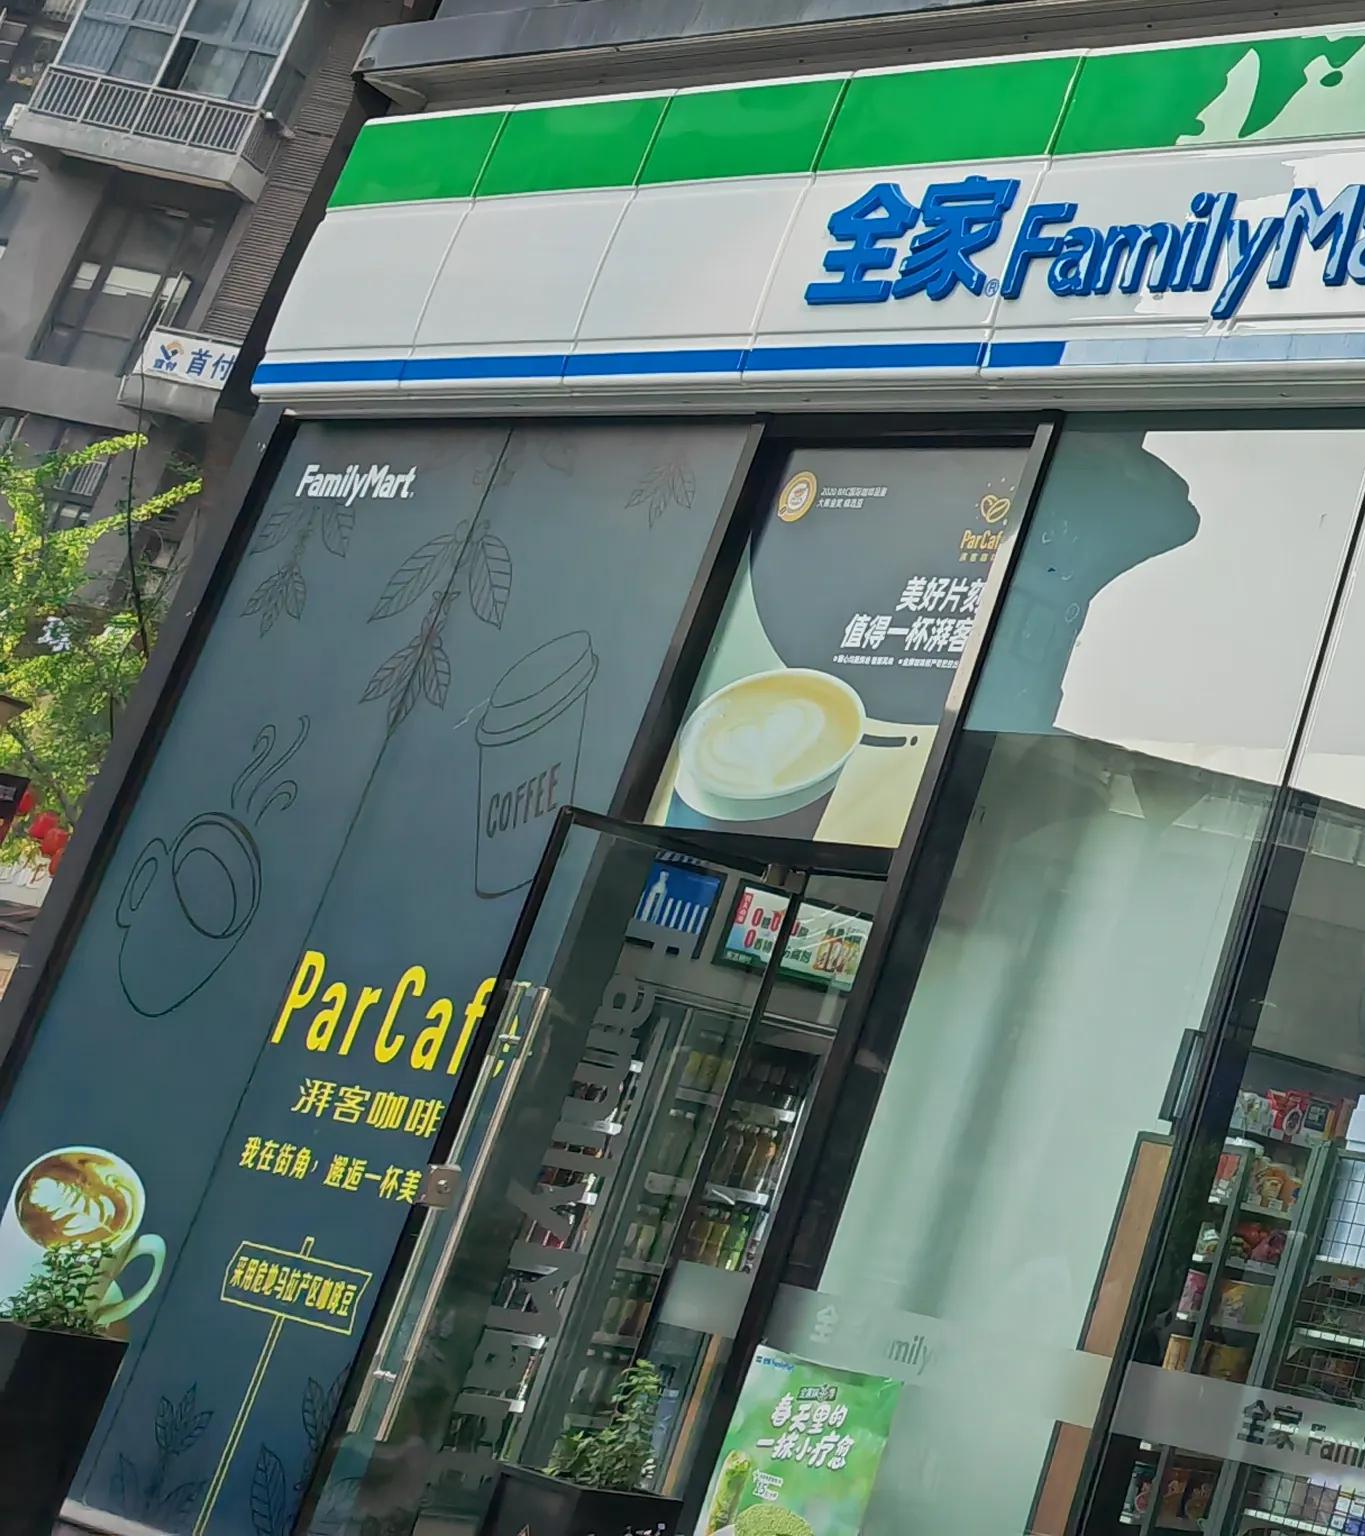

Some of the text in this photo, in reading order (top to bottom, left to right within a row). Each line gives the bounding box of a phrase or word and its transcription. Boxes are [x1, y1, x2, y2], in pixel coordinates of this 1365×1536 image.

[805, 175, 1020, 305] 全家
[295, 464, 415, 507] FamilyMart
[959, 530, 1003, 550] ParCaf
[486, 762, 561, 839] COFFEE
[290, 1077, 442, 1140] 湃客咖啡
[771, 1392, 848, 1434] 春天里的
[756, 1431, 855, 1470] 一抹小疗愈
